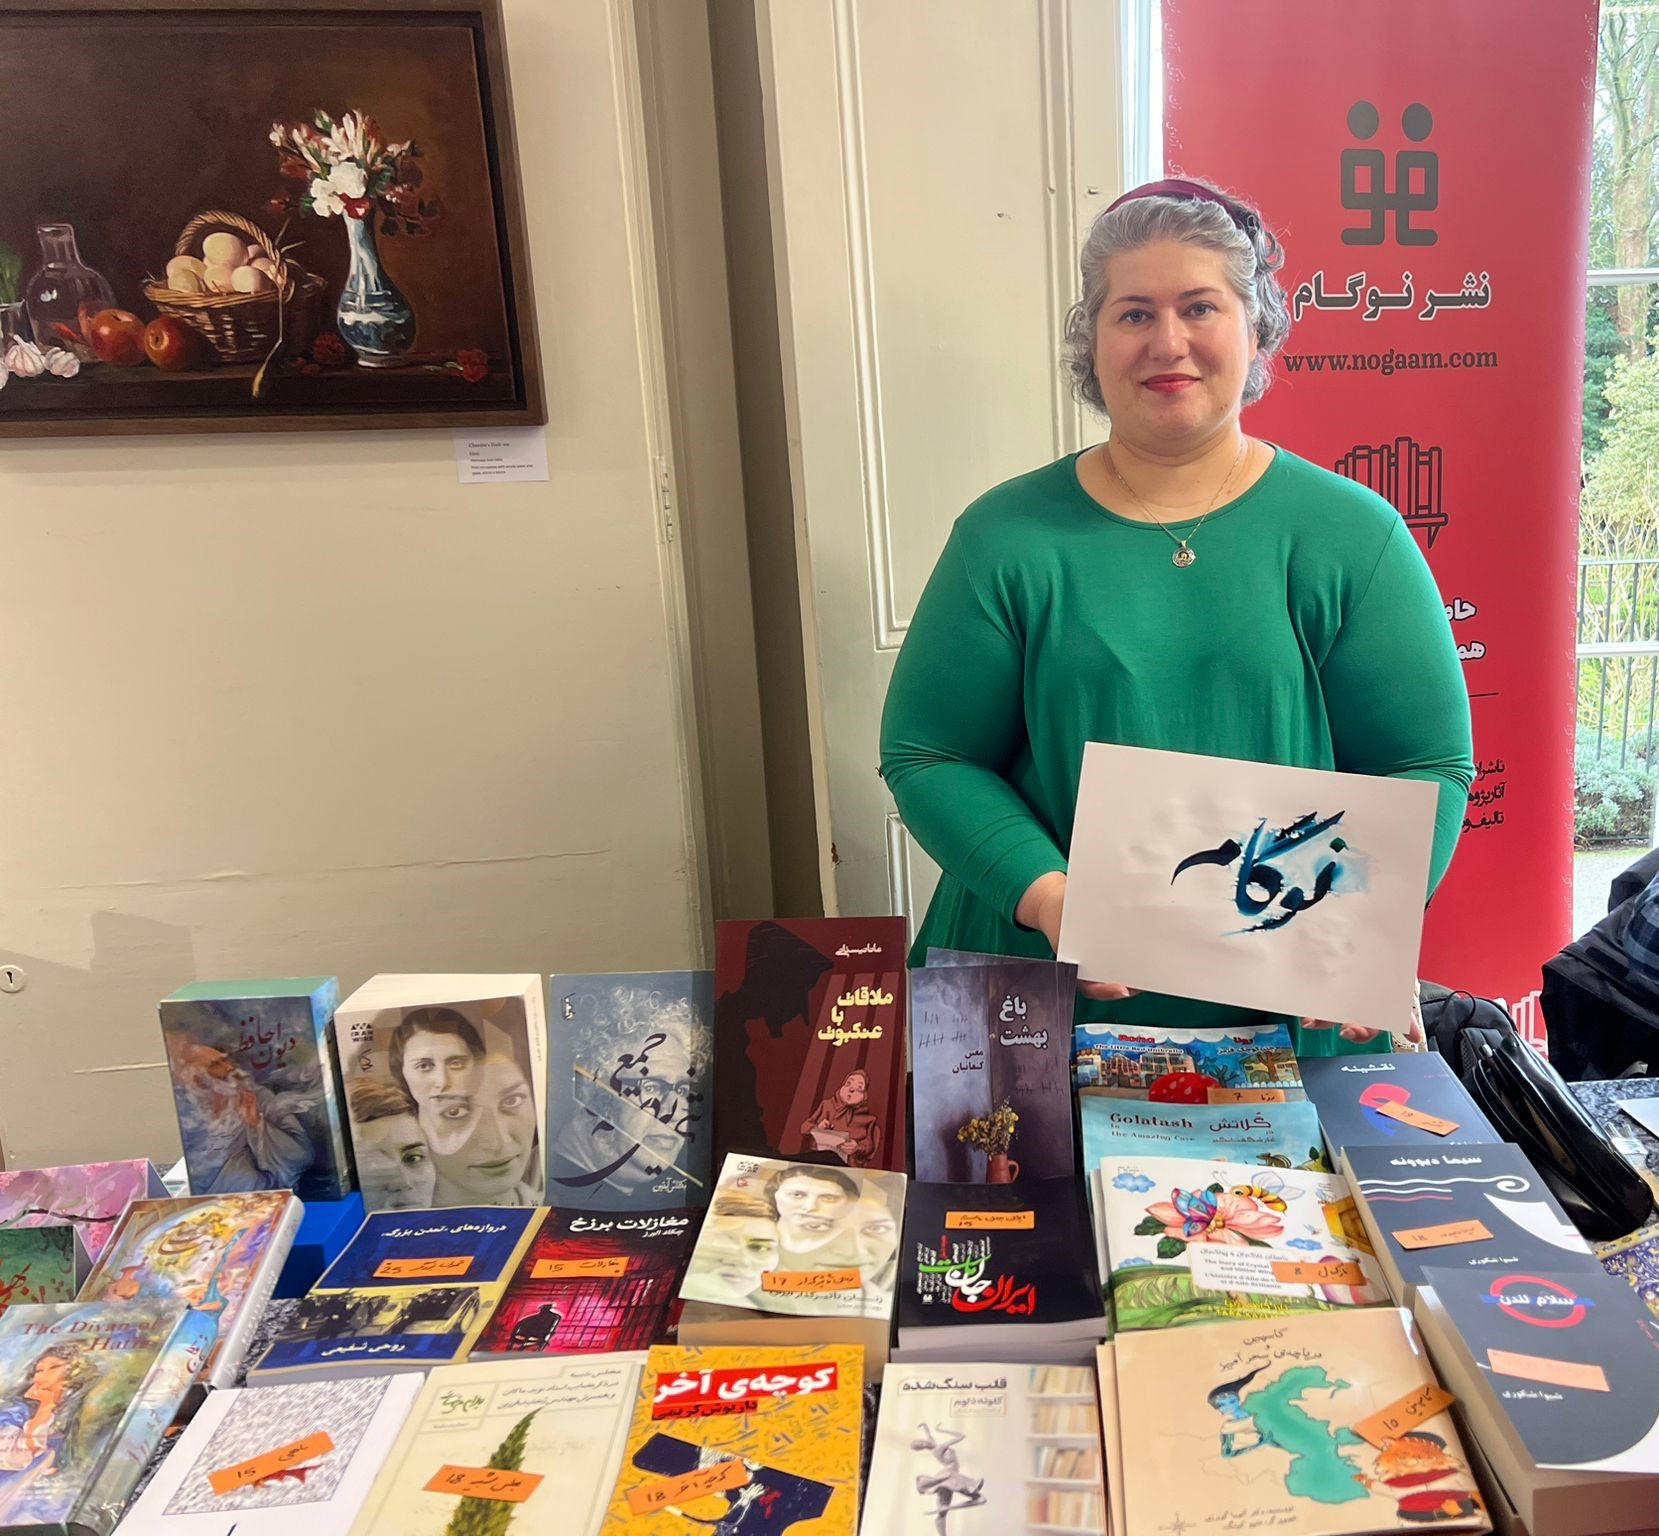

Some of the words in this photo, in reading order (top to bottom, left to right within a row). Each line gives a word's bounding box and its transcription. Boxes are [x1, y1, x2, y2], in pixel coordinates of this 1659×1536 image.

[1292, 270, 1413, 321] نوگام
[1418, 270, 1492, 321] نشر
[1284, 348, 1498, 375] www.nogaam.com
[837, 986, 894, 1006] ملاقات
[831, 1005, 844, 1026] با
[999, 994, 1028, 1022] باغ
[818, 1022, 883, 1046] عنکبوت
[1000, 1026, 1049, 1049] بهشت
[1341, 1063, 1396, 1074] نقشینه
[1110, 1112, 1194, 1128] Golatash
[1390, 1157, 1440, 1168] دیوونه
[1442, 1156, 1482, 1165] سیما
[569, 1217, 613, 1232] برزخ
[616, 1216, 689, 1231] مغازلات
[380, 1266, 402, 1274] 25
[549, 1264, 564, 1272] 15
[952, 1274, 1036, 1316] ایران
[1499, 1293, 1530, 1307] لندن
[1536, 1293, 1576, 1306] سلام
[23, 1323, 61, 1335] The
[69, 1321, 131, 1334] Divan
[653, 1369, 715, 1404] آخر
[975, 1377, 1008, 1391] قلب
[652, 1404, 703, 1420] کریمی
[701, 1401, 758, 1417] داریوش
[237, 1466, 256, 1478] 15
[446, 1473, 465, 1484] 18
[647, 1491, 666, 1503] 18
